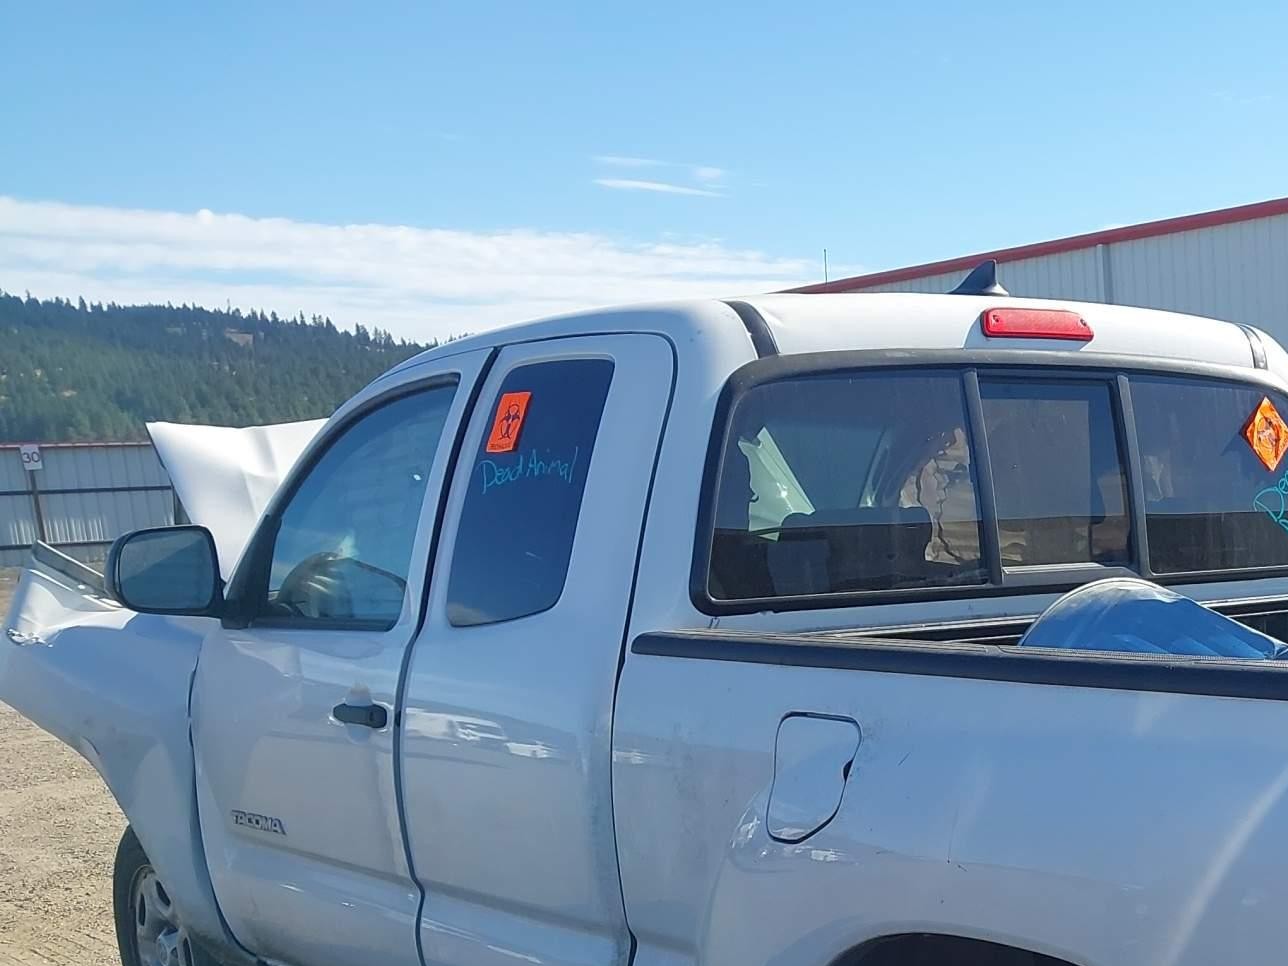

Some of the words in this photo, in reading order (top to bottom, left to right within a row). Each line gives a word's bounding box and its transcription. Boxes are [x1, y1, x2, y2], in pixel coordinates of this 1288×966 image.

[22, 451, 41, 463] 30
[476, 455, 524, 494] Dead
[526, 446, 578, 484] Animal
[231, 809, 287, 835] TACOMA
